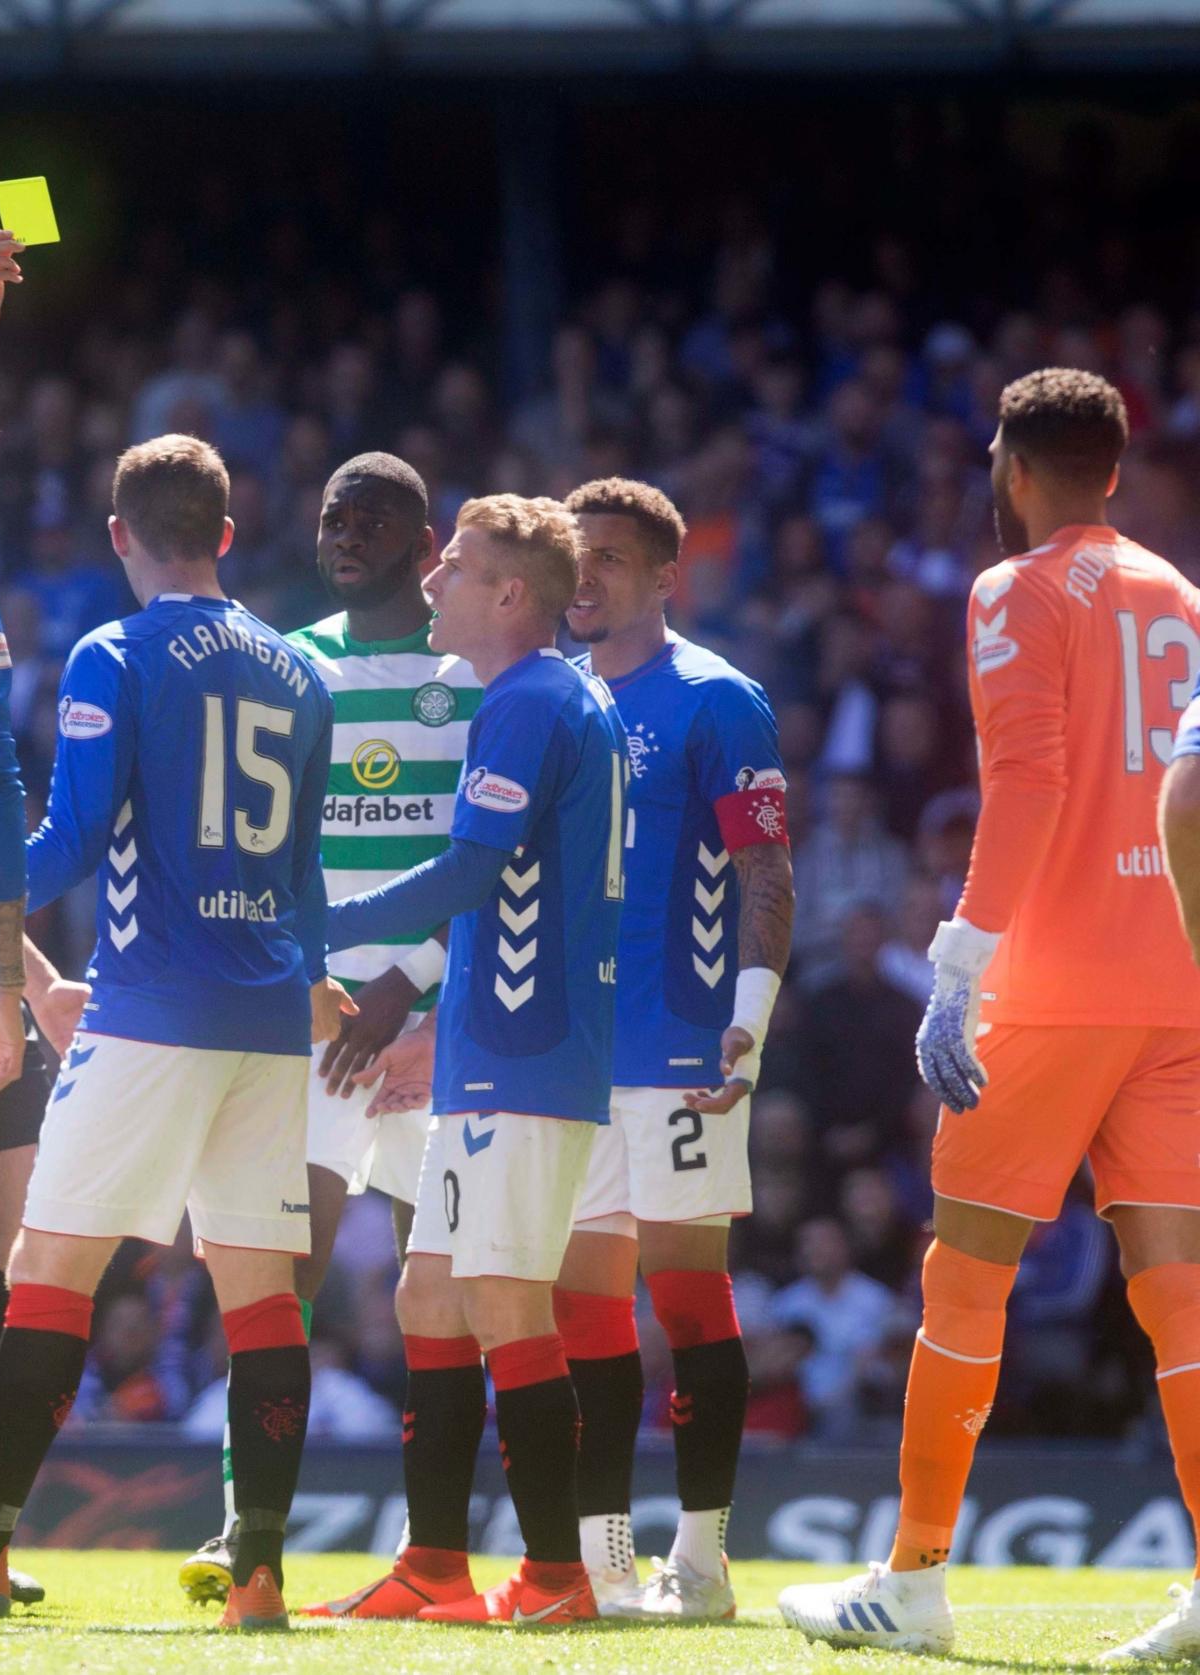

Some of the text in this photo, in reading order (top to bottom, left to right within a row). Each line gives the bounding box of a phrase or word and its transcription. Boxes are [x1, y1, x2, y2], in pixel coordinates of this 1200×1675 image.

[168, 620, 310, 697] FLANAGAN
[1115, 609, 1200, 774] 13
[198, 693, 296, 856] 15
[322, 796, 434, 827] dafabet
[668, 1108, 707, 1171] 2
